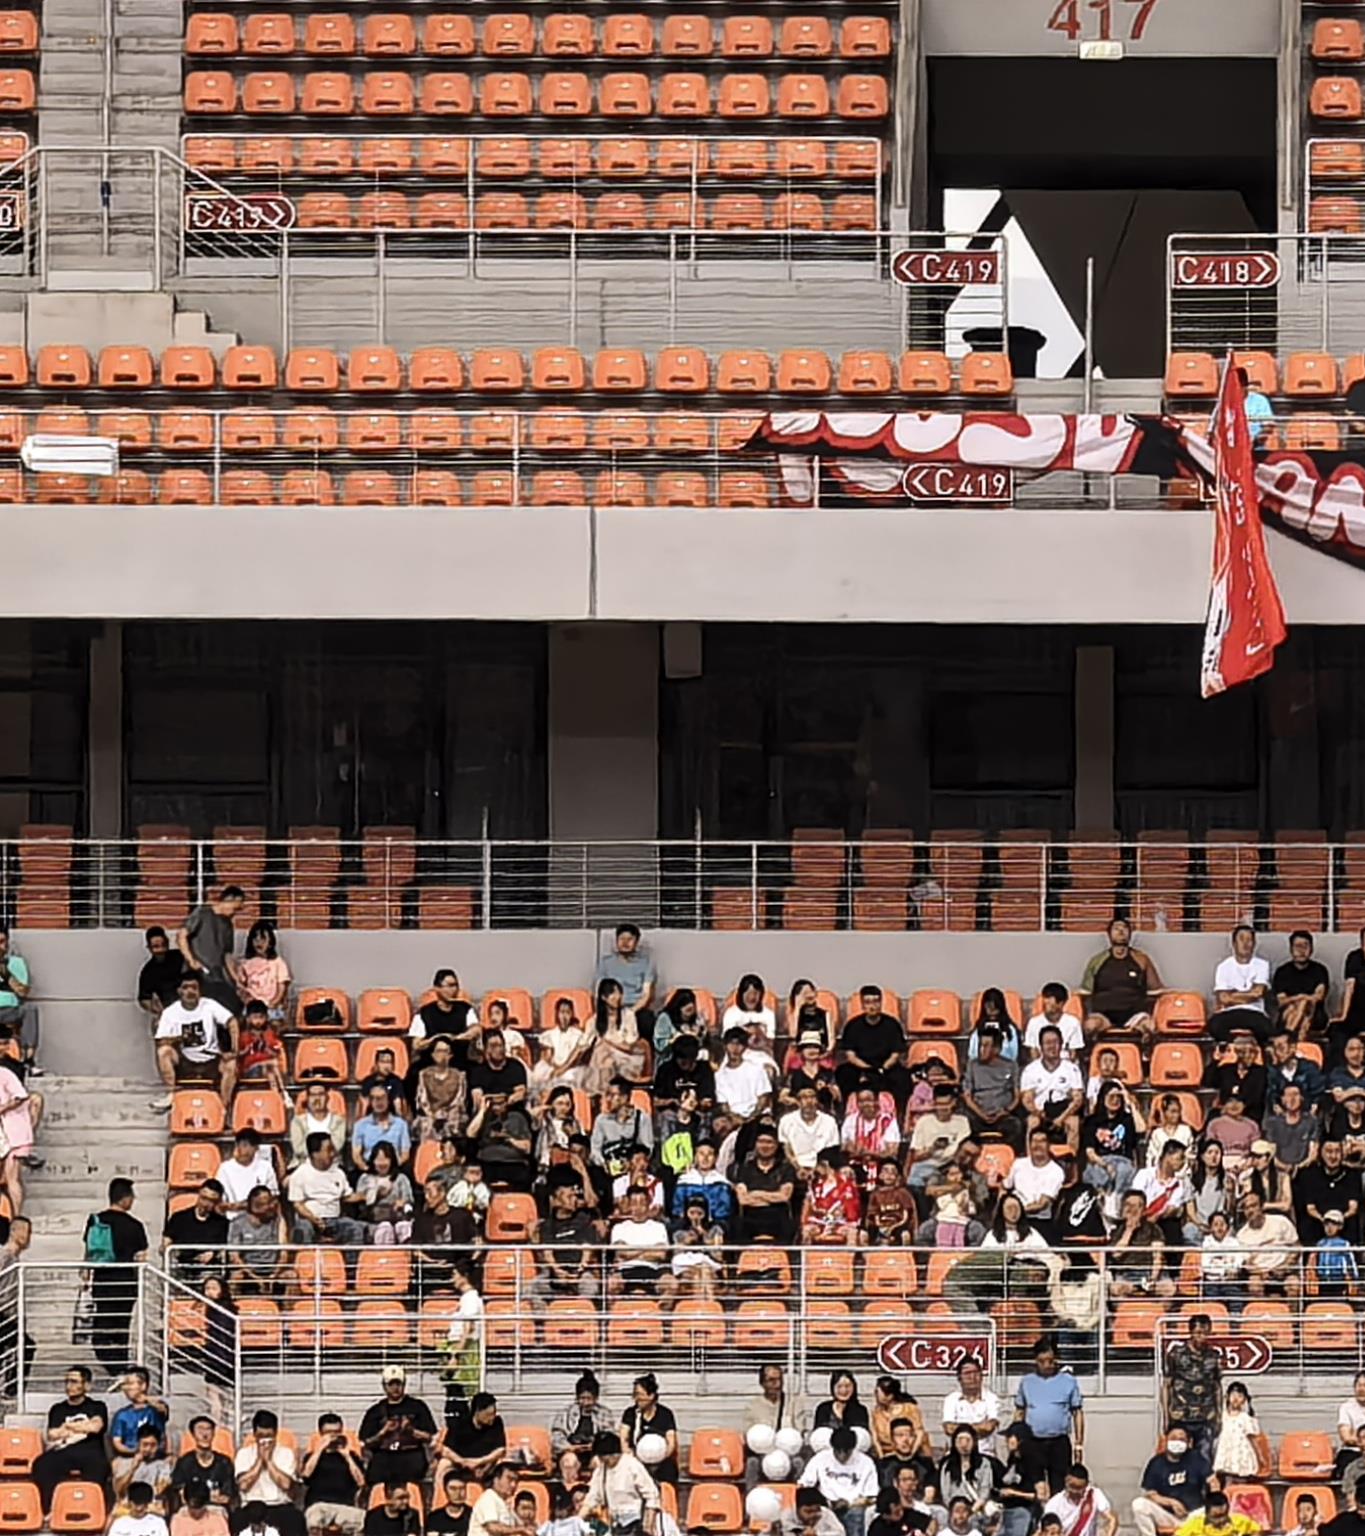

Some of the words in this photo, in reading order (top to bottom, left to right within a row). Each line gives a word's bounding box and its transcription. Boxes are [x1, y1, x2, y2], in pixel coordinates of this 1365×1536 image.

[1048, 0, 1156, 41] 417
[922, 254, 994, 283] C419
[1179, 255, 1248, 284] C418
[934, 469, 1005, 496] C419
